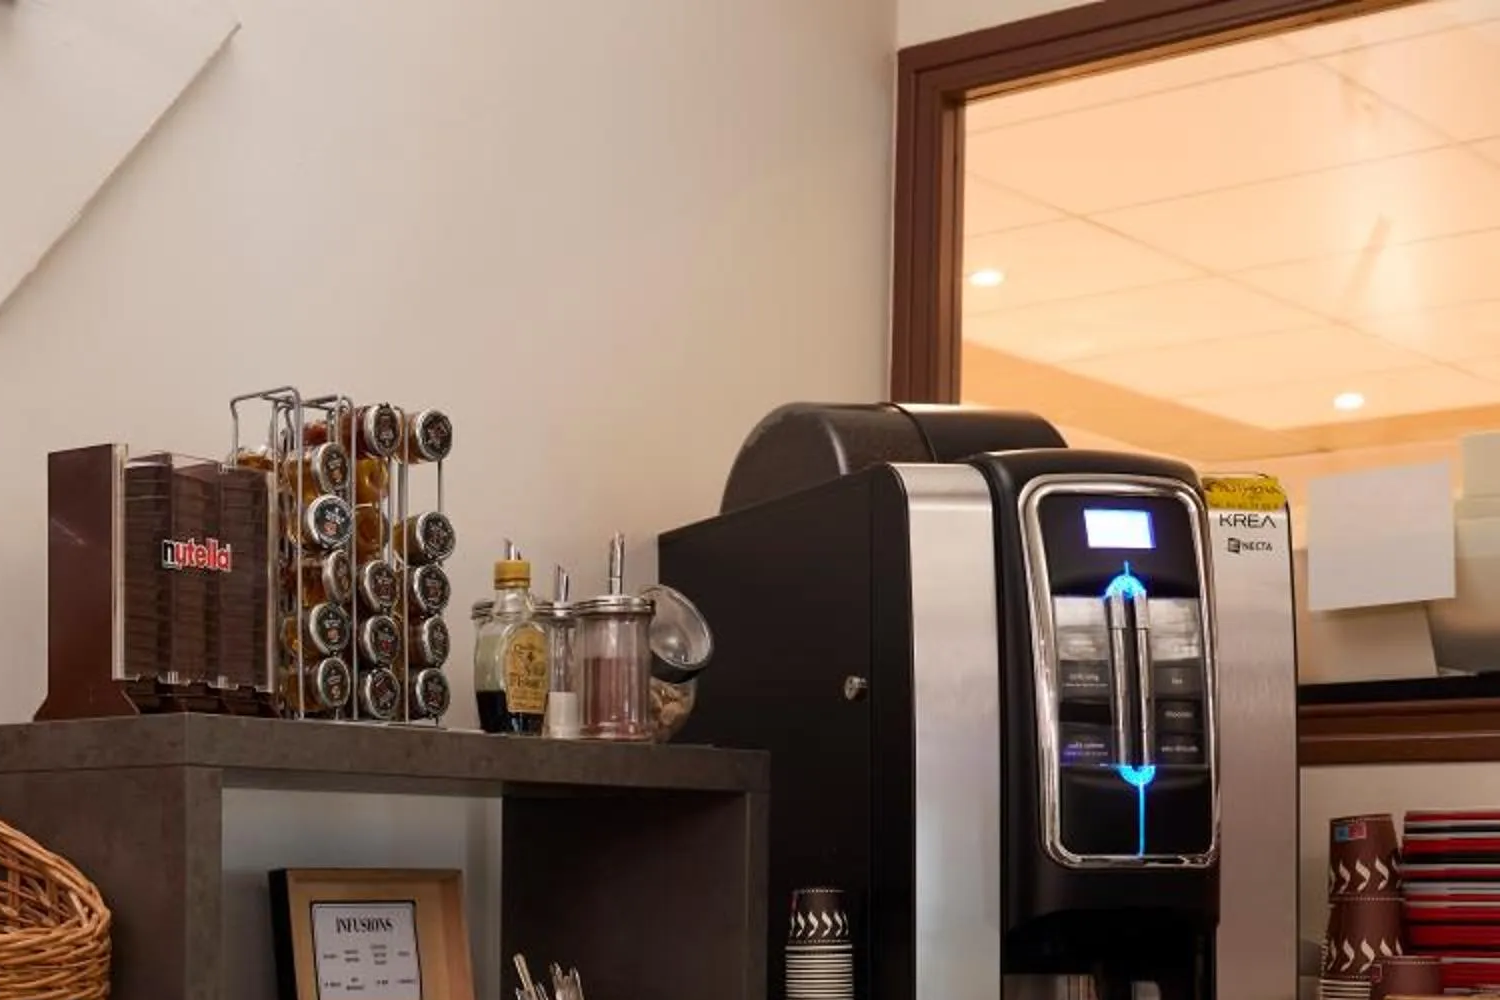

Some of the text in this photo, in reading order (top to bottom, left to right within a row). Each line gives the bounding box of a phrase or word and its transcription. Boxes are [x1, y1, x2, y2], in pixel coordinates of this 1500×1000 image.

[1219, 513, 1277, 529] KREA
[1241, 541, 1273, 552] NECTA
[162, 538, 232, 573] nutella
[335, 917, 394, 934] INFUSIONS
